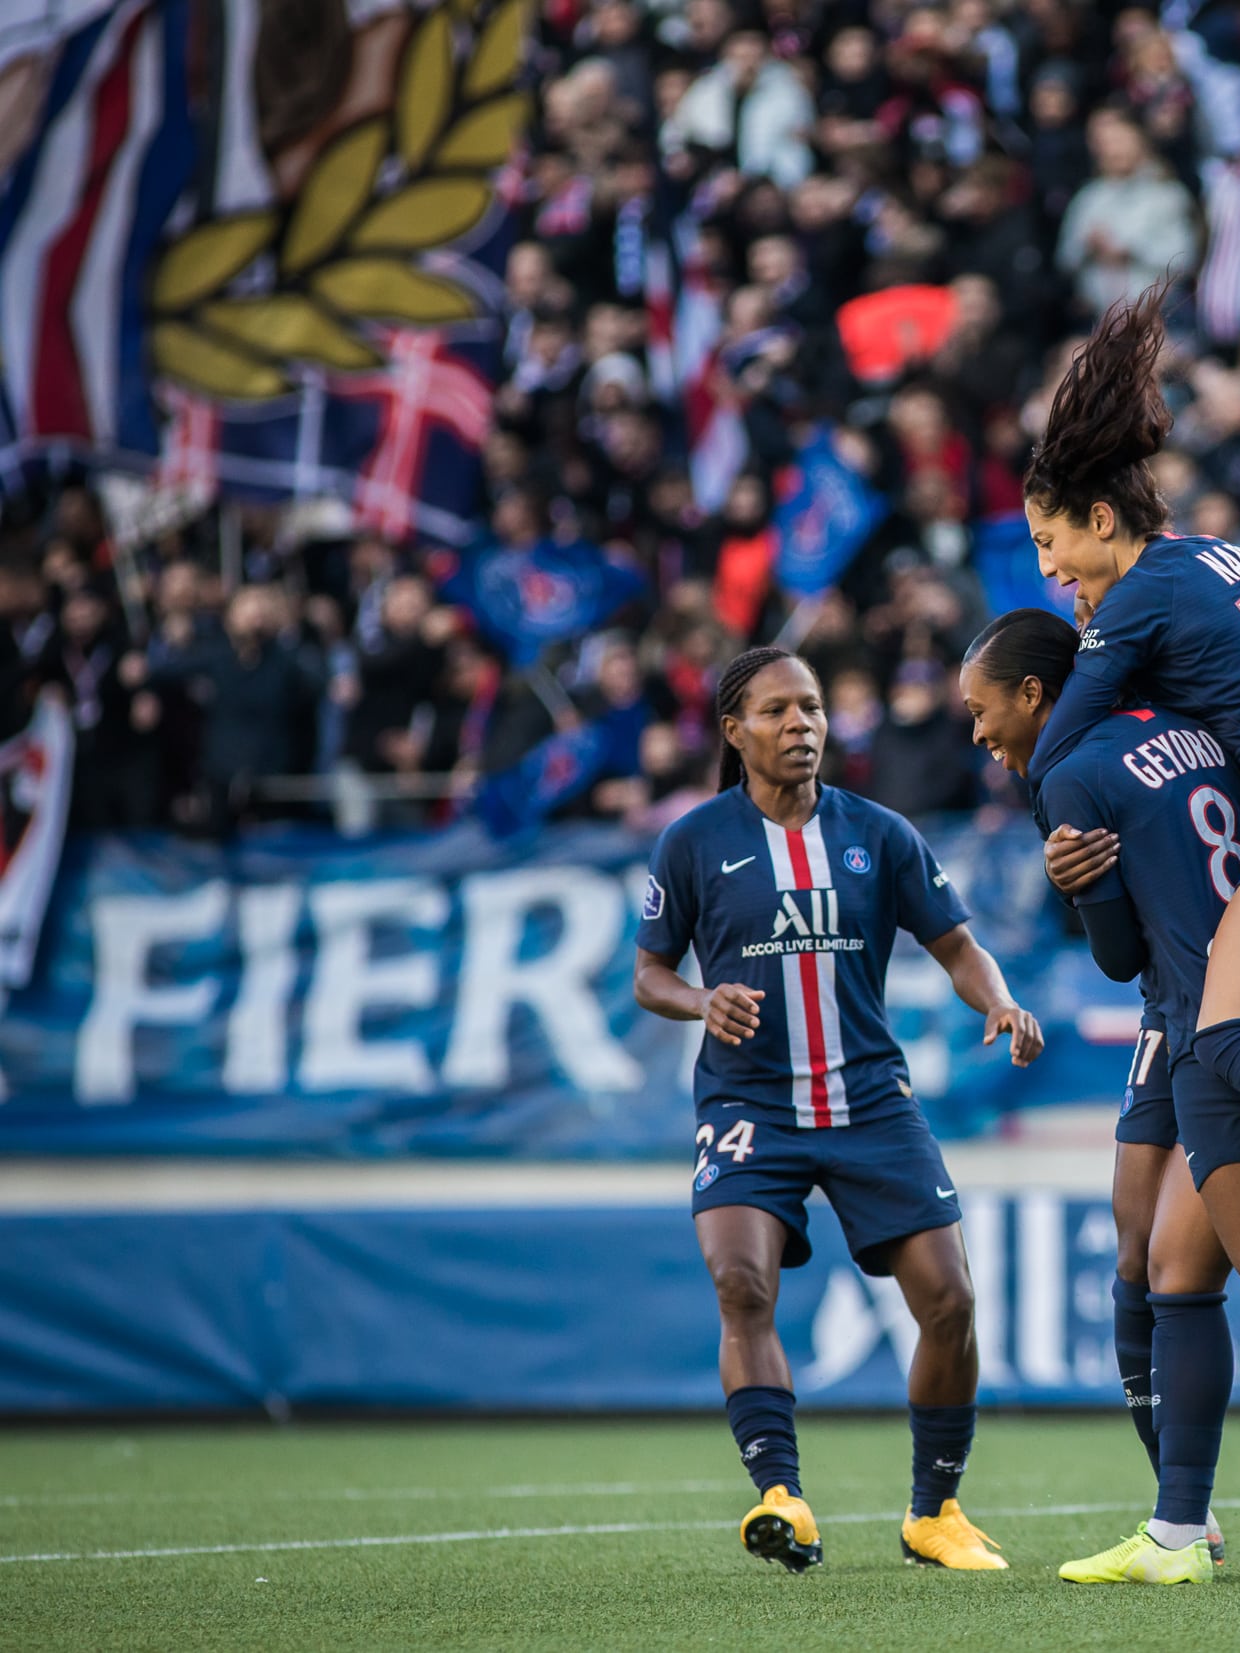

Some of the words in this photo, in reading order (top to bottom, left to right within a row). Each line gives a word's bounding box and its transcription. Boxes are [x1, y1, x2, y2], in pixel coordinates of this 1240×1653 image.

[1123, 729, 1226, 790] GEYORO
[741, 941, 785, 958] ACCOR
[786, 940, 814, 952] LIVE
[815, 939, 865, 951] LIMITLESS
[693, 1120, 755, 1178] 24
